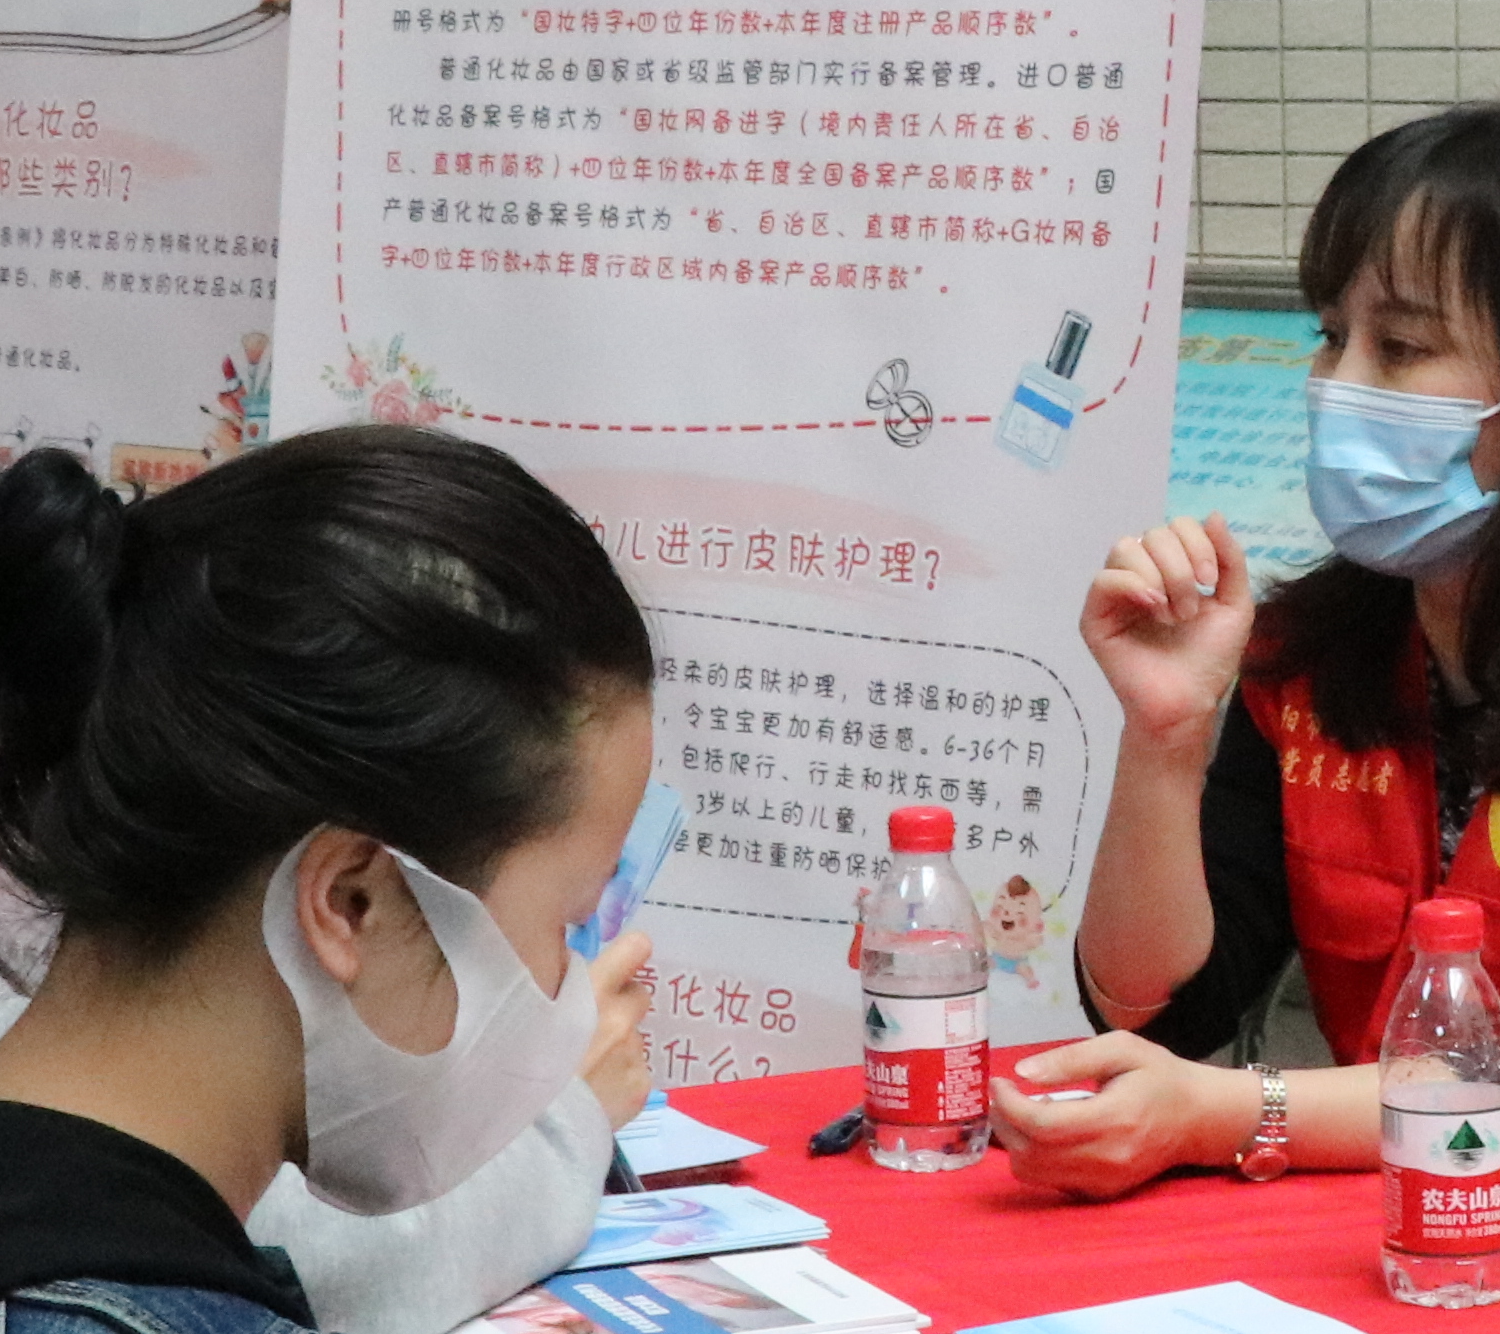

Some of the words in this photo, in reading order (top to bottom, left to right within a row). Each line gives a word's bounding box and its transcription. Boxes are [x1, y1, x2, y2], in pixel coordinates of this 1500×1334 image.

[695, 792, 869, 837] 3岁以上的儿童，
[1422, 1212, 1468, 1226] NONGFU
